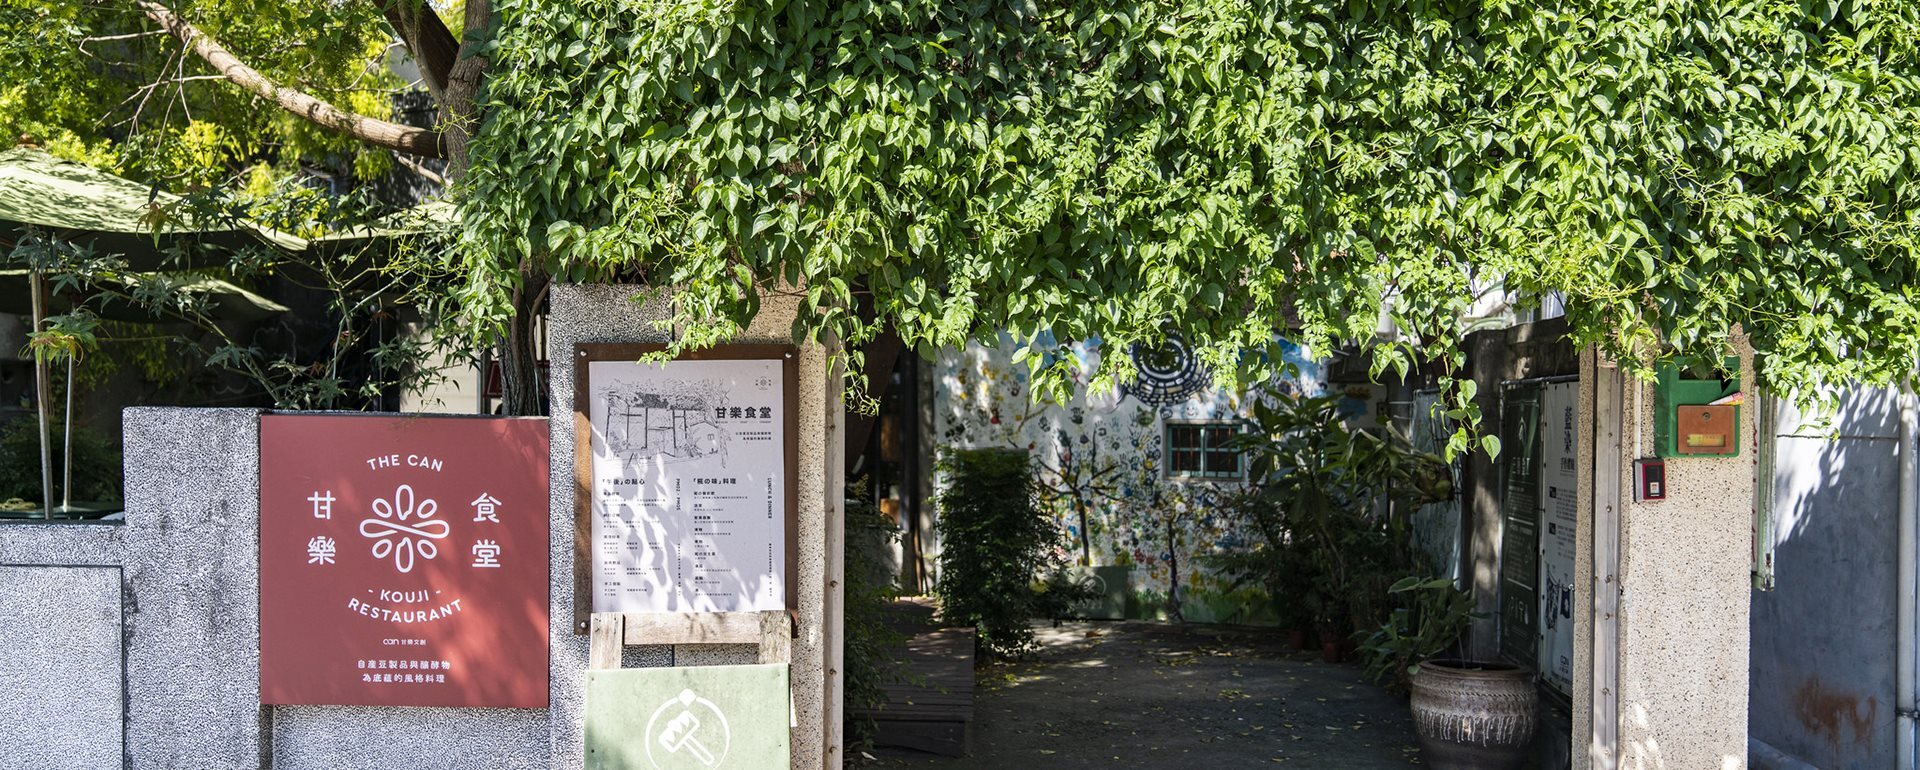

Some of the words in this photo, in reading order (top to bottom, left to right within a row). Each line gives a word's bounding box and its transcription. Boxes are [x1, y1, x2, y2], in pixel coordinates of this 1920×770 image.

[715, 406, 772, 419] 甘樂食堂
[366, 454, 400, 471] THE
[407, 454, 443, 472] CAN
[471, 492, 502, 568] 食堂
[380, 589, 429, 604] KOUJI
[347, 597, 462, 623] RESTAURANT
